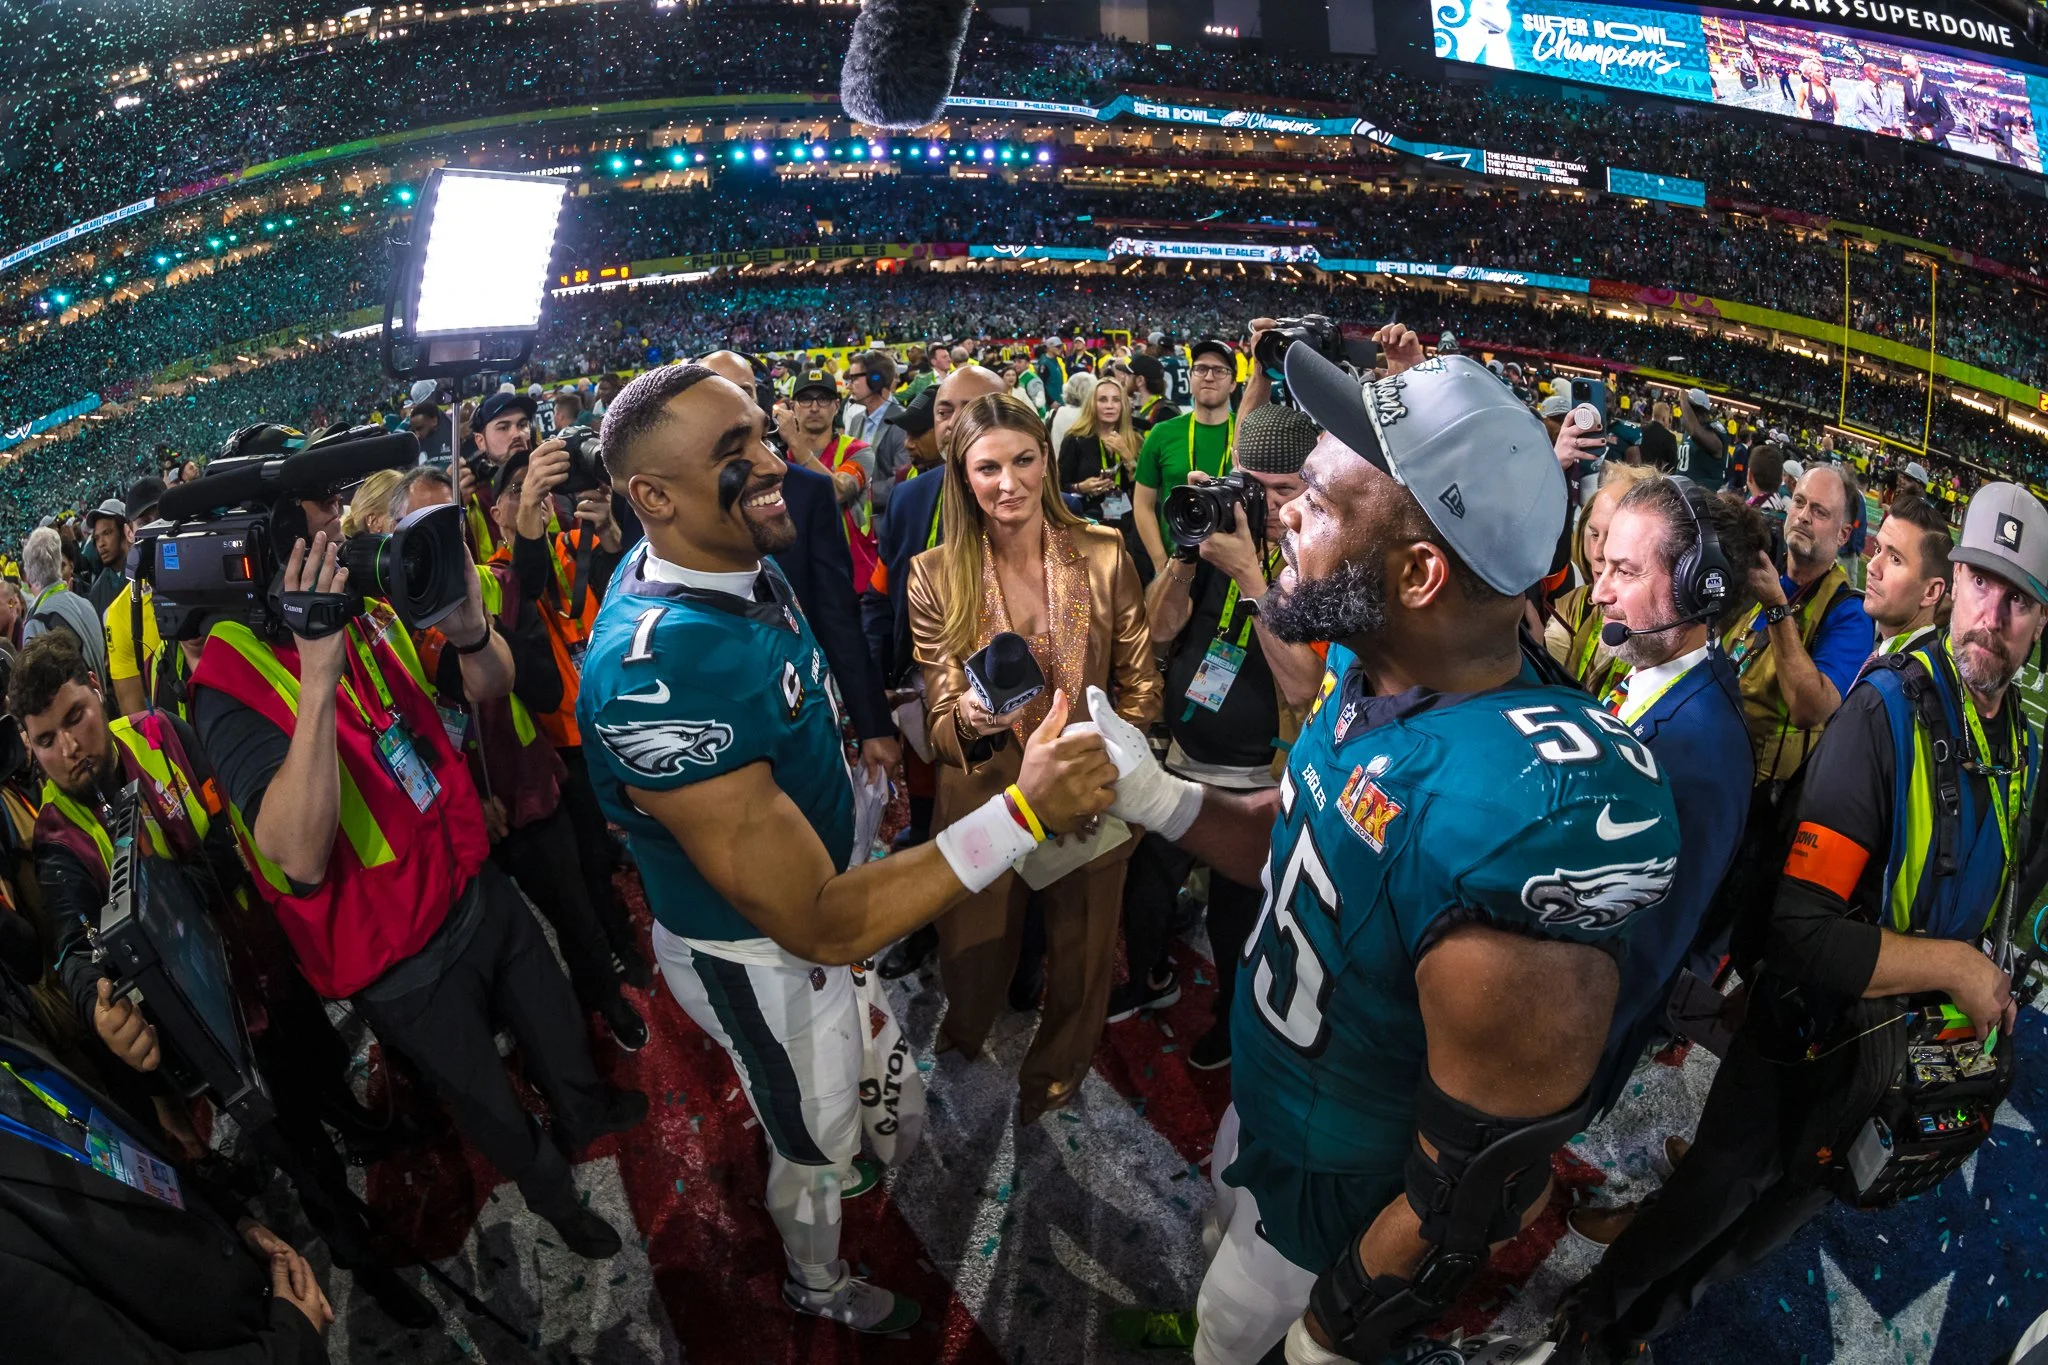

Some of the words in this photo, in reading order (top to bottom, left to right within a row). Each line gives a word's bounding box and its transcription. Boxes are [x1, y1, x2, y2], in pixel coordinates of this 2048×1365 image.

[1522, 14, 1589, 37] SUPER
[1593, 20, 1686, 49] BOWL
[1854, 0, 2015, 48] SUPERDOME
[1532, 28, 1681, 75] Champions
[1133, 101, 1170, 119] SUPER
[1173, 108, 1219, 124] BOWL
[1246, 112, 1321, 135] Champions
[1487, 152, 1500, 160] THE
[1501, 154, 1526, 163] EAGLES
[1527, 157, 1555, 166] SHOWED
[1563, 162, 1588, 172] TODAY.
[1487, 160, 1504, 168] THEY
[1505, 162, 1525, 170] WERE
[1488, 167, 1505, 176] THEY
[1505, 170, 1527, 178] NEVER
[1541, 174, 1555, 182] THE
[1555, 176, 1579, 185] CHIEFS
[692, 247, 812, 267] PHILADELPHIA
[818, 244, 886, 259] EAGLES
[1159, 245, 1222, 256] PHILADELPHIA
[1225, 248, 1265, 258] EAGLES
[1375, 261, 1408, 274] SUPER
[1410, 264, 1447, 277] BOWL
[223, 540, 244, 548] SONY
[283, 603, 303, 614] Canon
[623, 607, 666, 662] 1
[1504, 704, 1661, 782] 55
[1301, 762, 1327, 812] EAGLES
[1339, 802, 1354, 827] SUPER
[1354, 824, 1376, 848] BOWL
